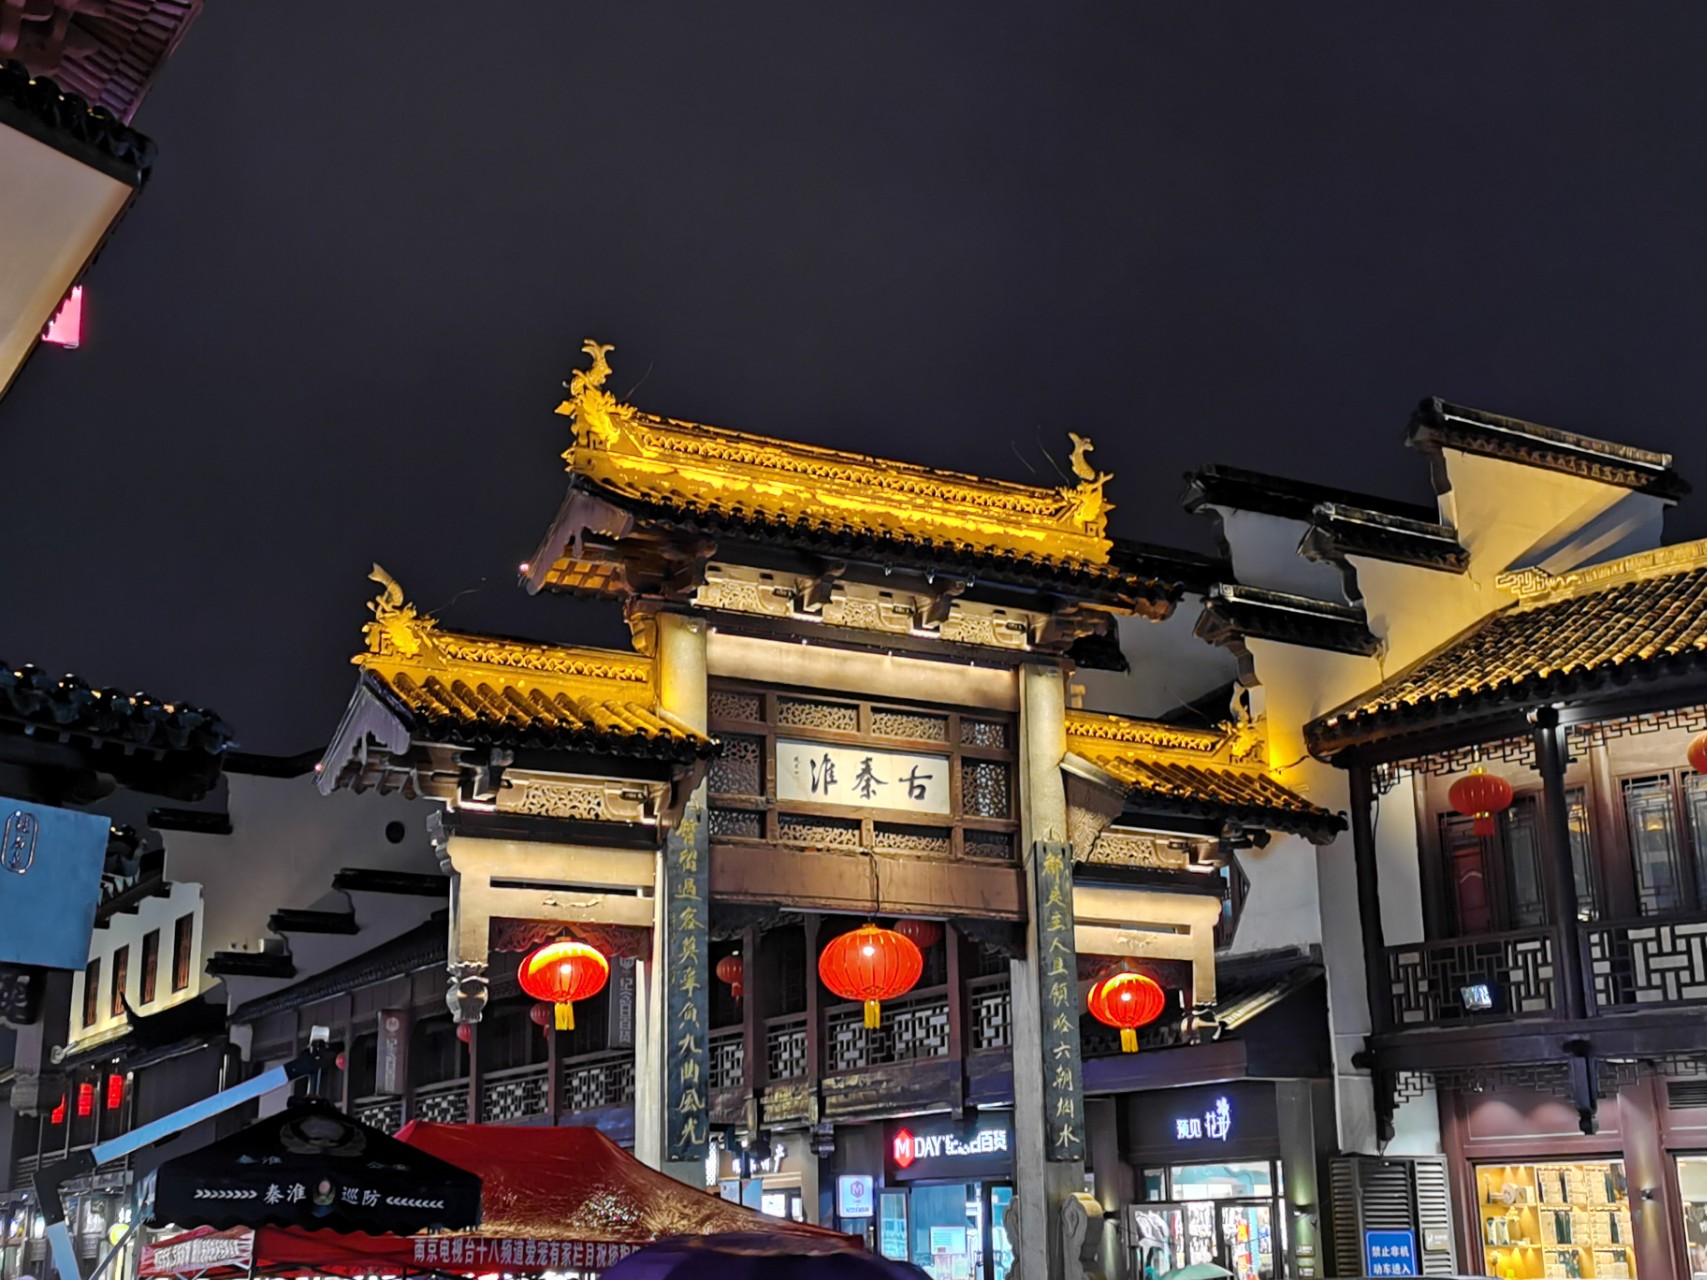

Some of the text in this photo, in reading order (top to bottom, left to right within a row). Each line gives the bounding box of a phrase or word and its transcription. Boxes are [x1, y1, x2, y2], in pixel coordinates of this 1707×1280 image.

[263, 1183, 381, 1207] 秦淮 巡防
[1371, 1245, 1410, 1258] 禁止非机
[1373, 1262, 1411, 1275] 动车进入
